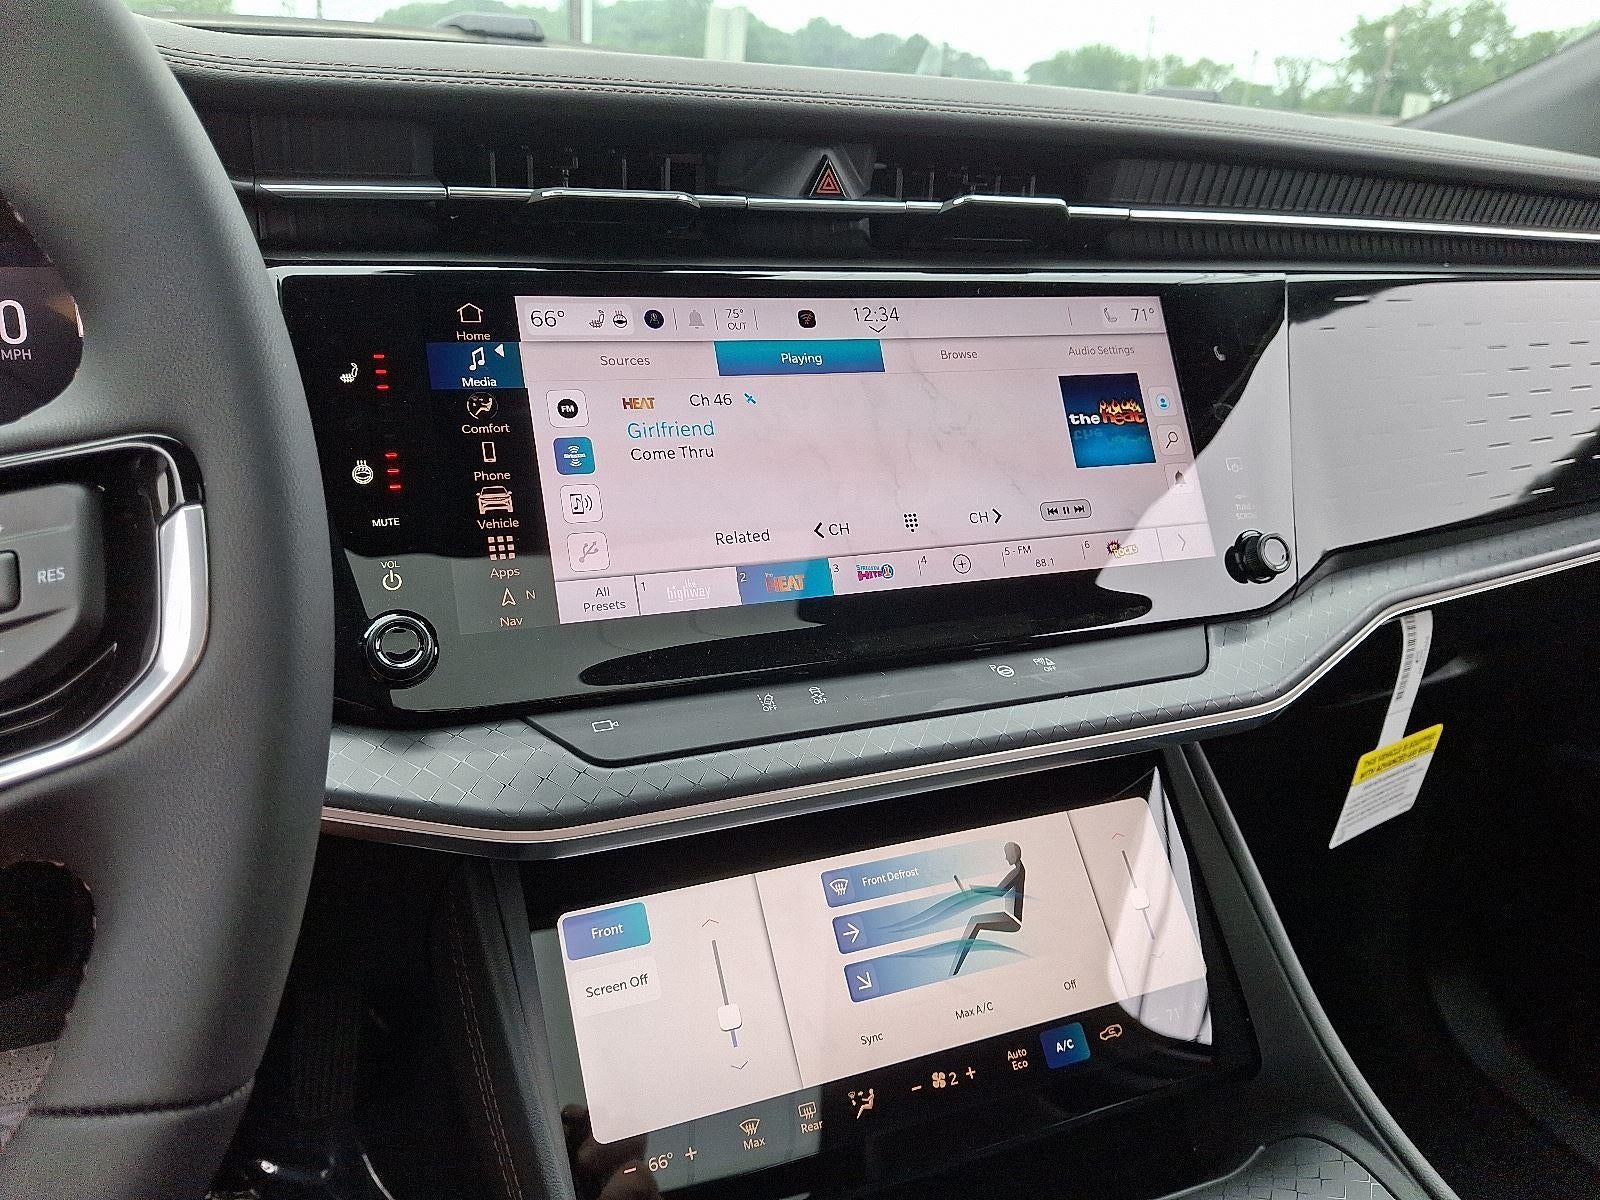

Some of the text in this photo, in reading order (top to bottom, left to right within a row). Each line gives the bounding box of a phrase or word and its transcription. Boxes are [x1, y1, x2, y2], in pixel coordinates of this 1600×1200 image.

[854, 307, 899, 322] 12:34
[727, 322, 747, 331] OUT
[456, 330, 491, 341] Home
[1, 349, 32, 361] MPH
[940, 349, 978, 360] Browse
[1068, 344, 1135, 357] Audio Settings
[600, 355, 651, 367] Sources
[781, 352, 823, 366] Playing
[461, 377, 497, 388] Media
[622, 397, 655, 410] HEAT
[689, 393, 733, 407] Ch 46
[560, 405, 575, 413] FM
[1069, 408, 1146, 426] the heat
[461, 423, 510, 434] Comfort
[627, 420, 715, 440] Girlfriend
[630, 446, 714, 461] Come Thru
[473, 470, 511, 481] Phone
[371, 517, 400, 527] MUTE
[477, 518, 520, 530] Vehicle
[969, 511, 989, 524] CH
[828, 523, 850, 536] CH
[715, 529, 771, 546] Related
[380, 560, 401, 569] VOL
[833, 564, 839, 573] 3
[1035, 558, 1055, 568] 88.1
[37, 567, 65, 583] RES
[490, 567, 520, 579] Apps
[740, 573, 747, 582] 2
[765, 575, 805, 592] HEAT
[526, 590, 536, 600] N
[595, 586, 610, 597] All
[666, 585, 711, 602] highway
[583, 600, 626, 613] Presets
[500, 616, 523, 627] Nav
[813, 697, 827, 705] OFF
[862, 867, 919, 887] Front Defrost
[591, 923, 624, 940] Front
[586, 973, 649, 998] Screen Off
[1063, 979, 1078, 991] Off
[955, 1001, 994, 1020] Max A/C
[860, 1031, 884, 1046] Sync
[1056, 1038, 1074, 1052] A/C
[1007, 1048, 1028, 1061] Auto
[1012, 1058, 1029, 1070] Eco
[949, 1072, 959, 1086] 2
[800, 1120, 823, 1134] Rear
[743, 1136, 766, 1150] Max
